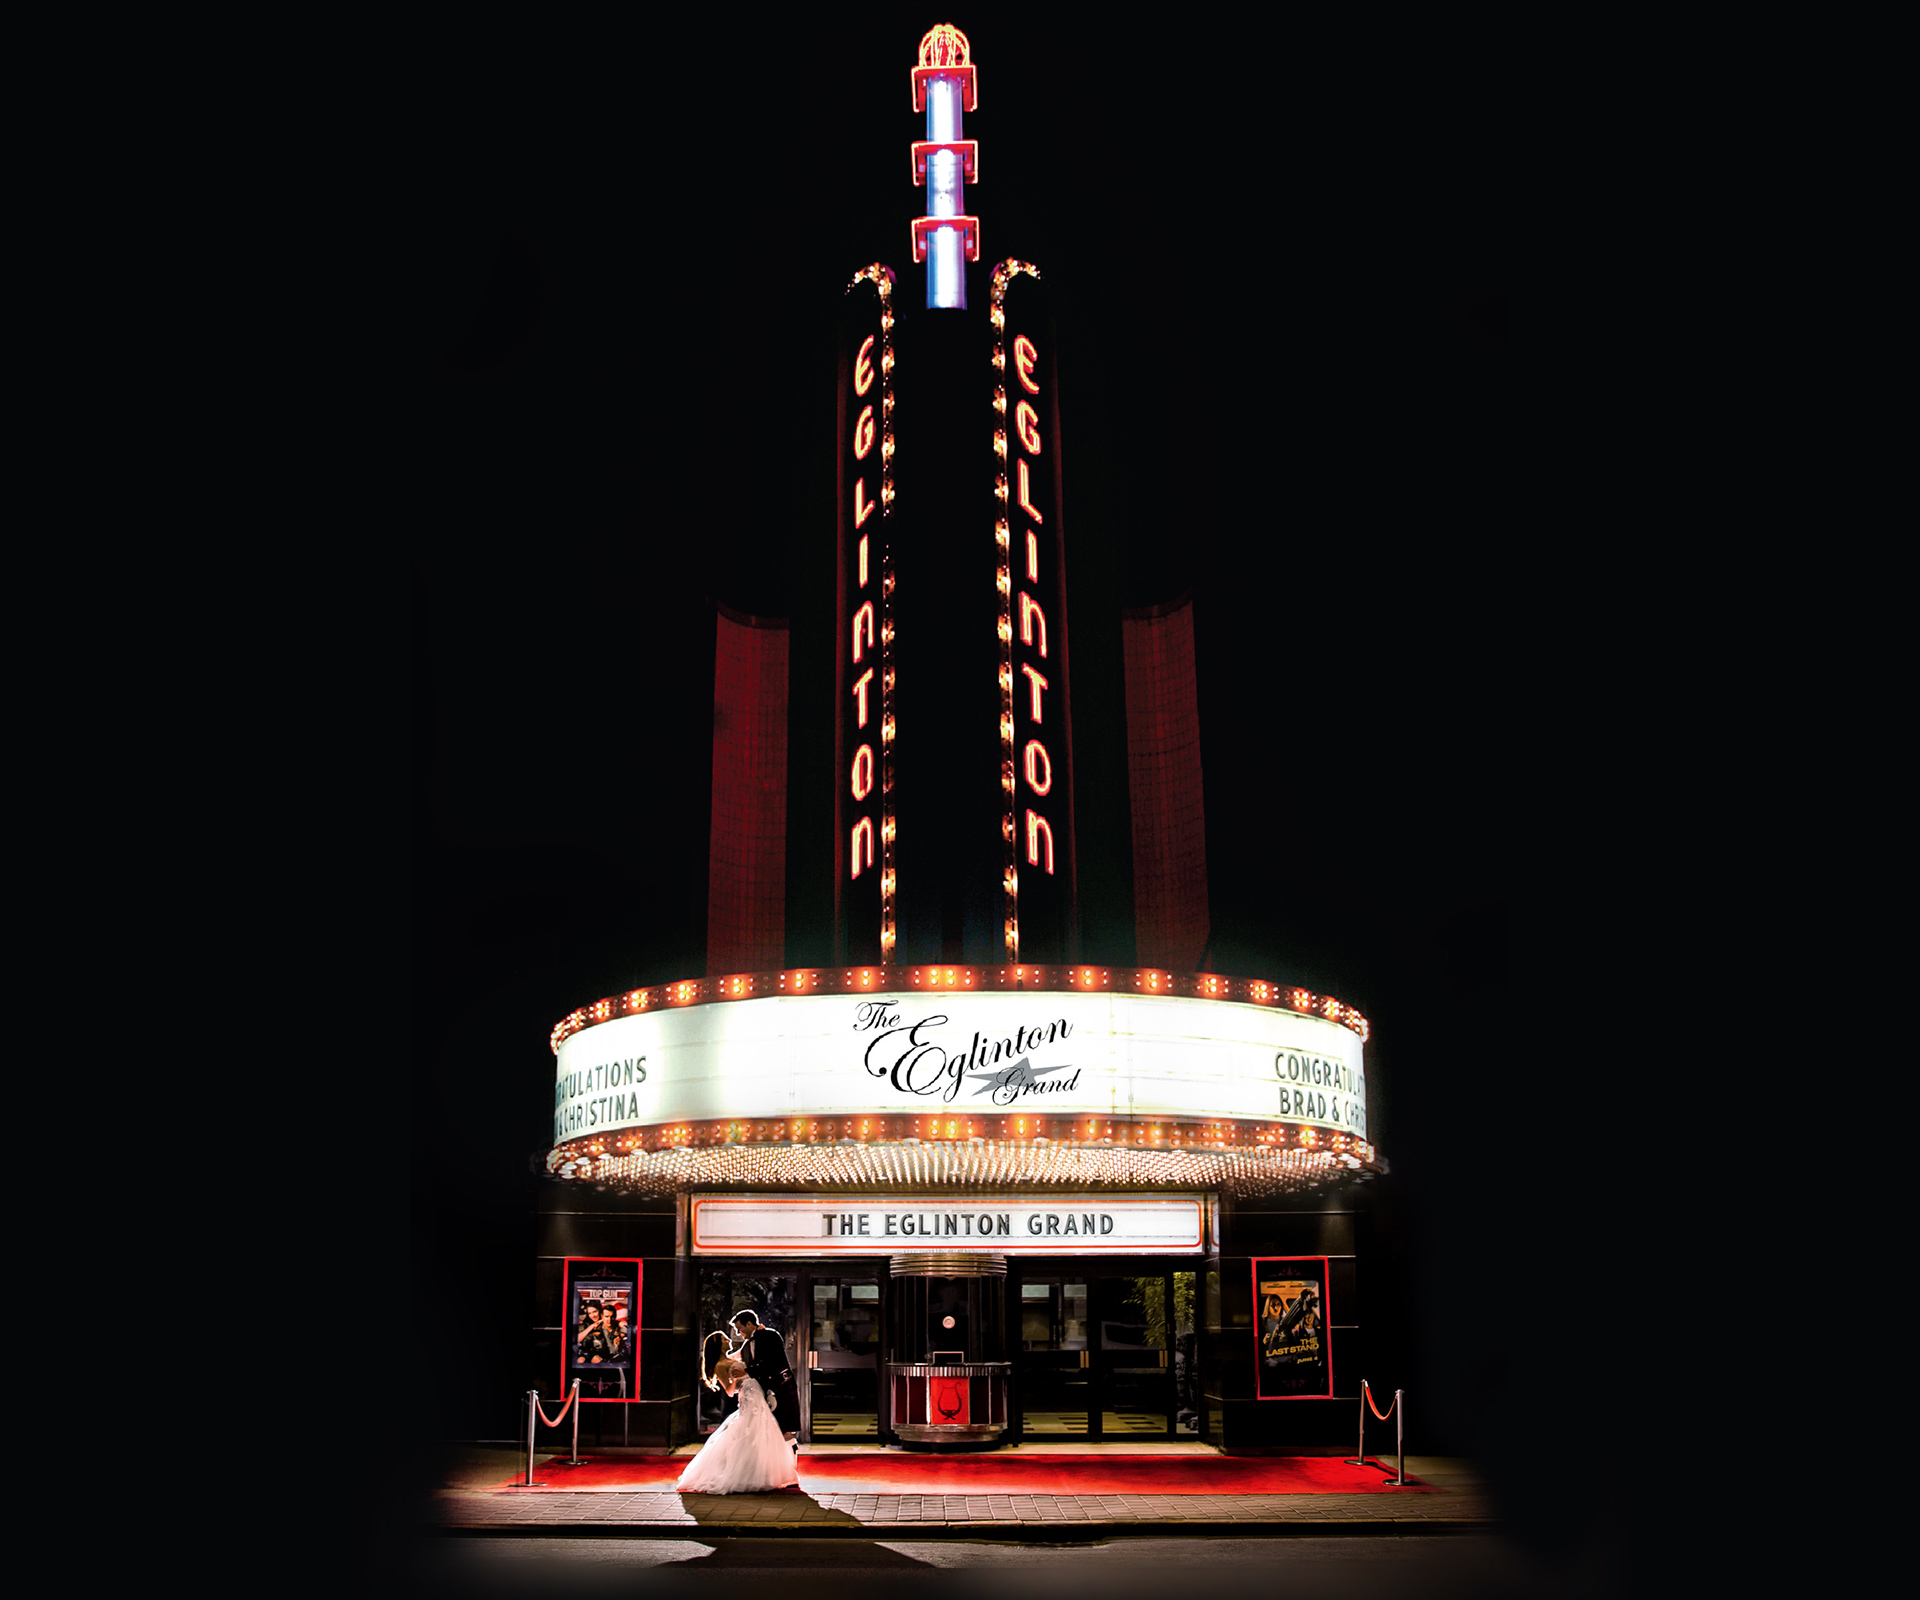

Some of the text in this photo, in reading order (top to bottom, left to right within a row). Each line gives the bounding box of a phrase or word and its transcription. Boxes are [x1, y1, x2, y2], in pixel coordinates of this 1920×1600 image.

[852, 335, 876, 880] EGLINTON
[1014, 334, 1054, 875] EGLINTON
[853, 999, 901, 1031] The
[864, 1015, 1074, 1103] Eglinton
[992, 1066, 1082, 1106] Grand
[1279, 1086, 1327, 1119] BRAD
[1332, 1095, 1340, 1122] &
[564, 1091, 639, 1134] CHRISTINA
[822, 1213, 1114, 1236] THE EGLINTON GRAND
[590, 1289, 618, 1299] TOP GUN
[1265, 1343, 1320, 1357] LAST STAND
[1300, 1337, 1318, 1345] THE
